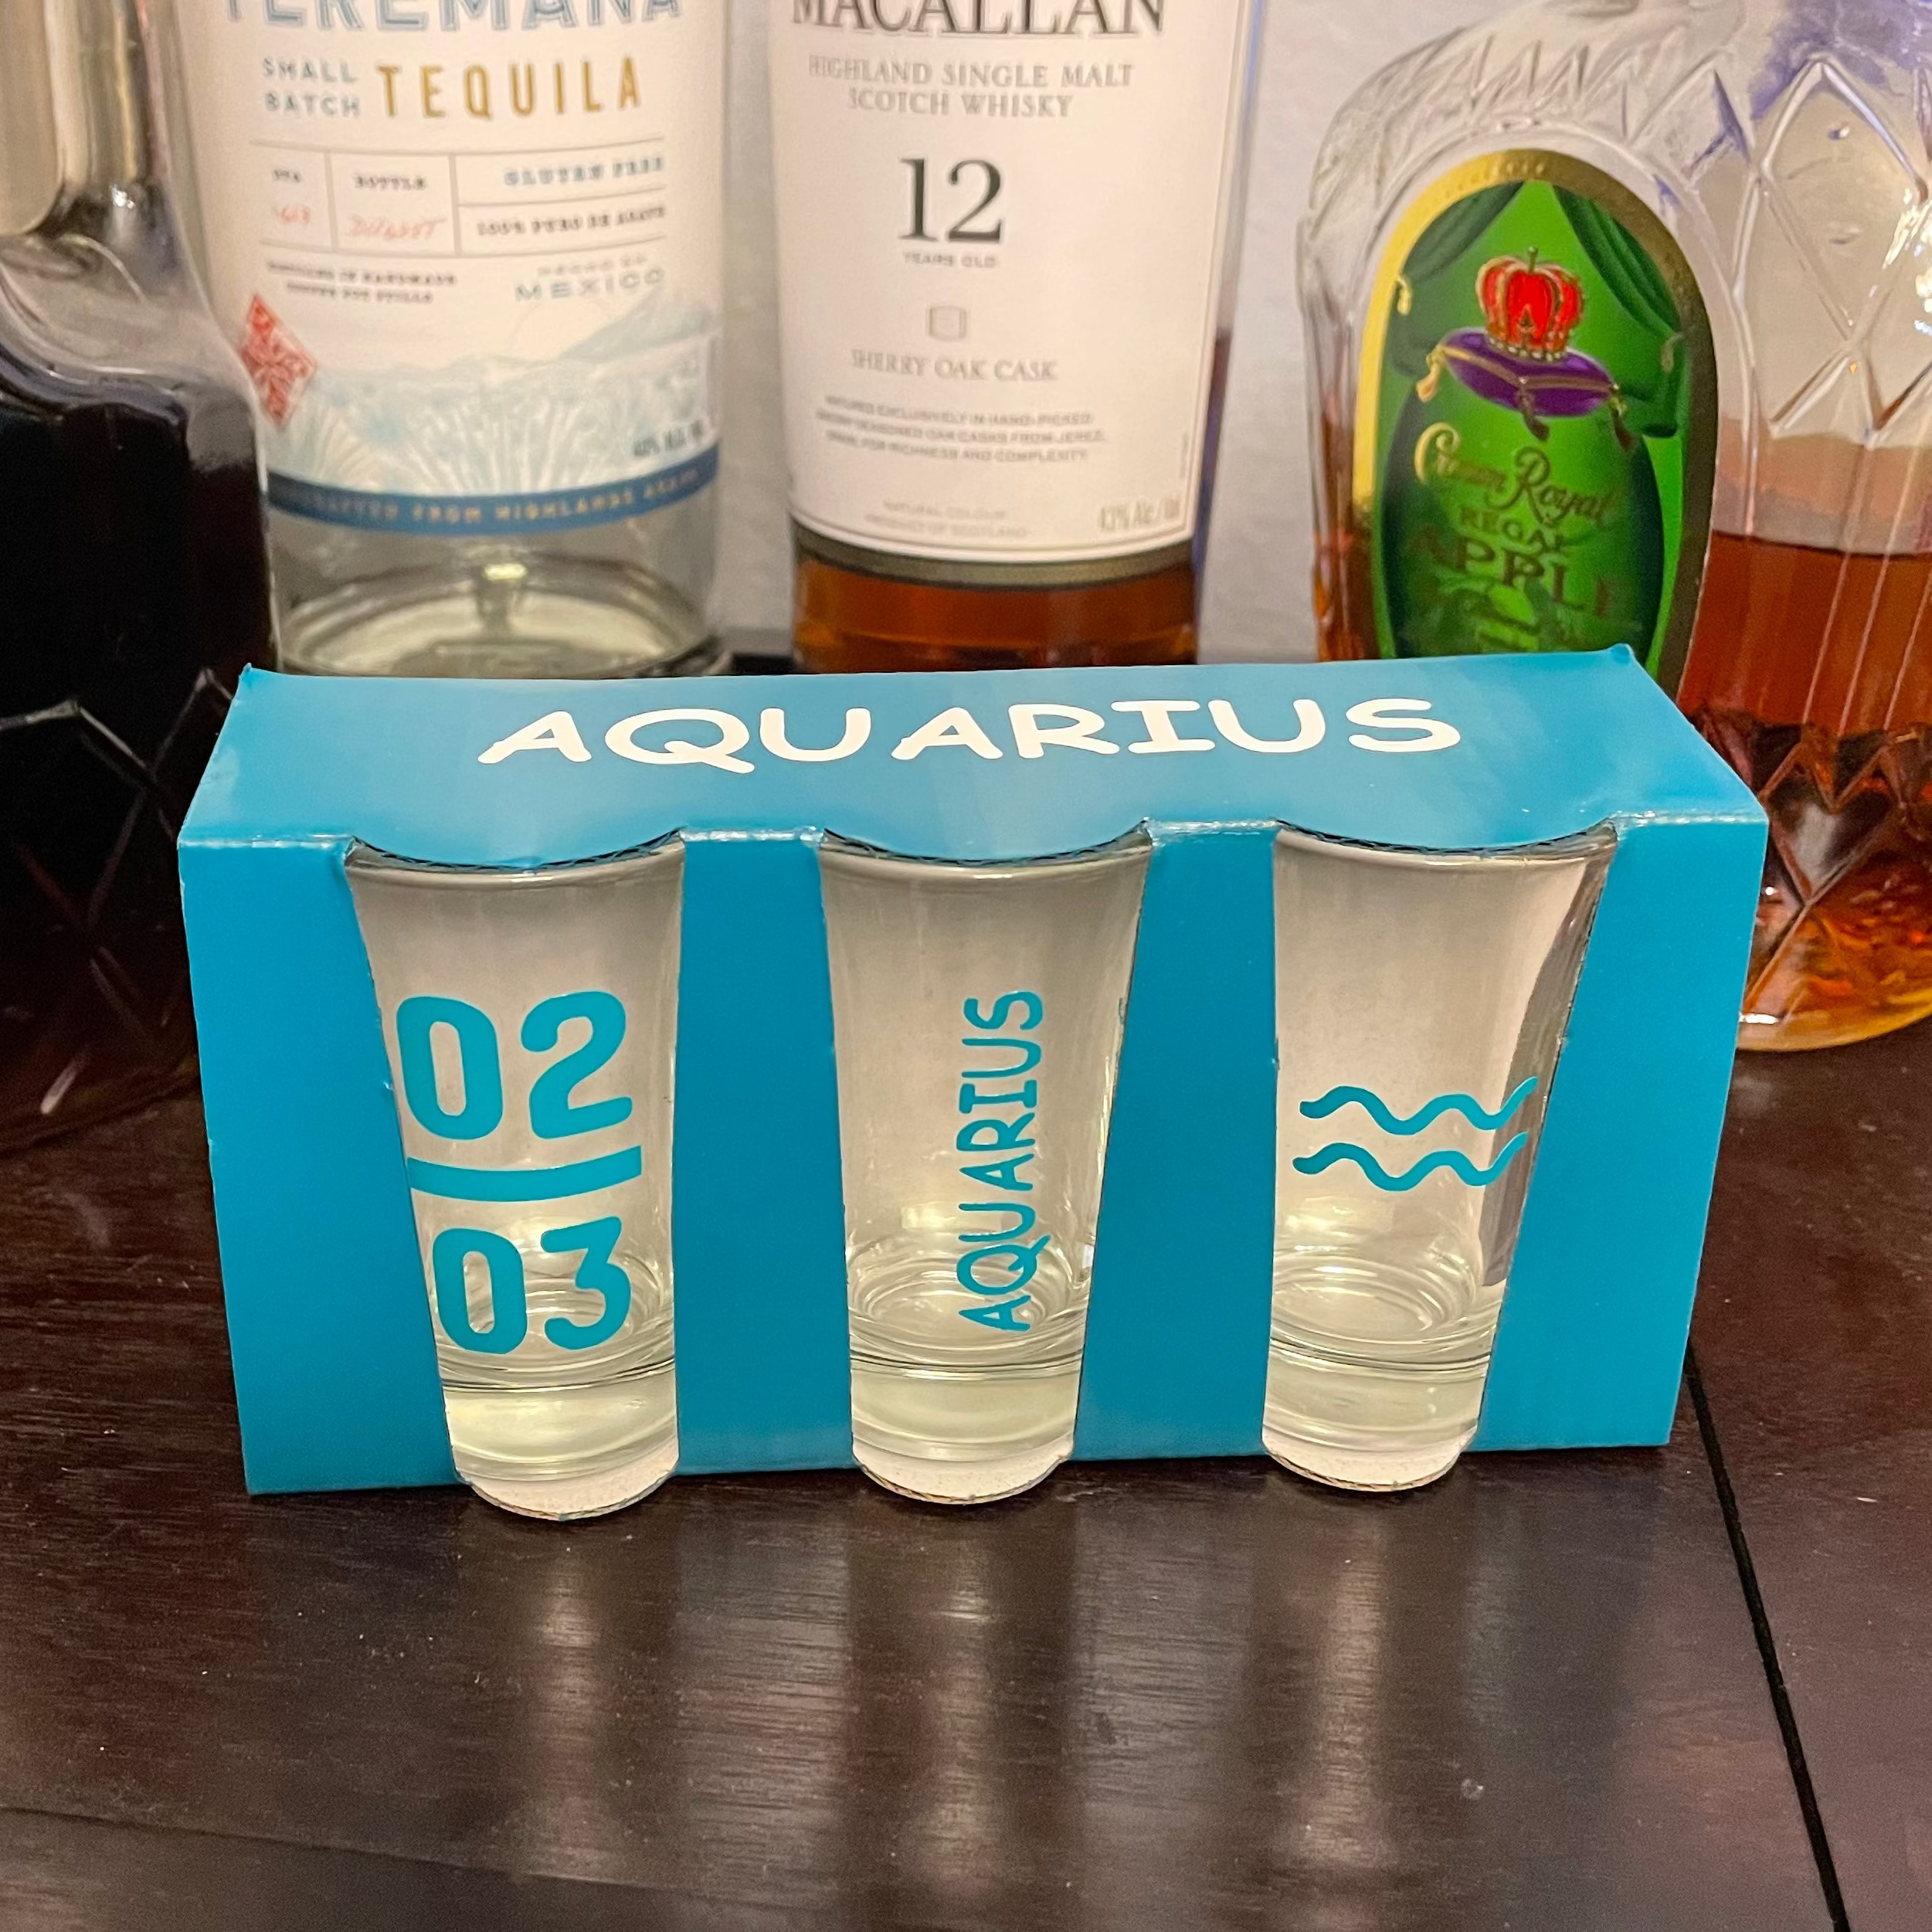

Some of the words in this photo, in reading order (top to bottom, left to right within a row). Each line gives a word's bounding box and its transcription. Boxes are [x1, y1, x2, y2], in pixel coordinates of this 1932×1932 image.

[263, 57, 358, 83] SMALL
[376, 55, 641, 120] TEQUILA
[809, 55, 932, 85] HIGHLAND
[942, 63, 1048, 88] SINGLE
[1061, 63, 1134, 88] MALT
[265, 93, 361, 117] BATCH
[850, 87, 949, 116] SCOTCH
[961, 93, 1075, 117] WHISKY
[898, 156, 1004, 244] 12
[514, 264, 666, 301] MEXICO
[851, 349, 928, 377] SHERRY
[935, 358, 987, 381] OAK
[993, 358, 1059, 382] CASK
[477, 698, 1462, 774] AQUARIUS
[396, 990, 633, 1141] 02
[956, 990, 1051, 1333] AQUARIUS
[433, 1216, 632, 1355] 03
